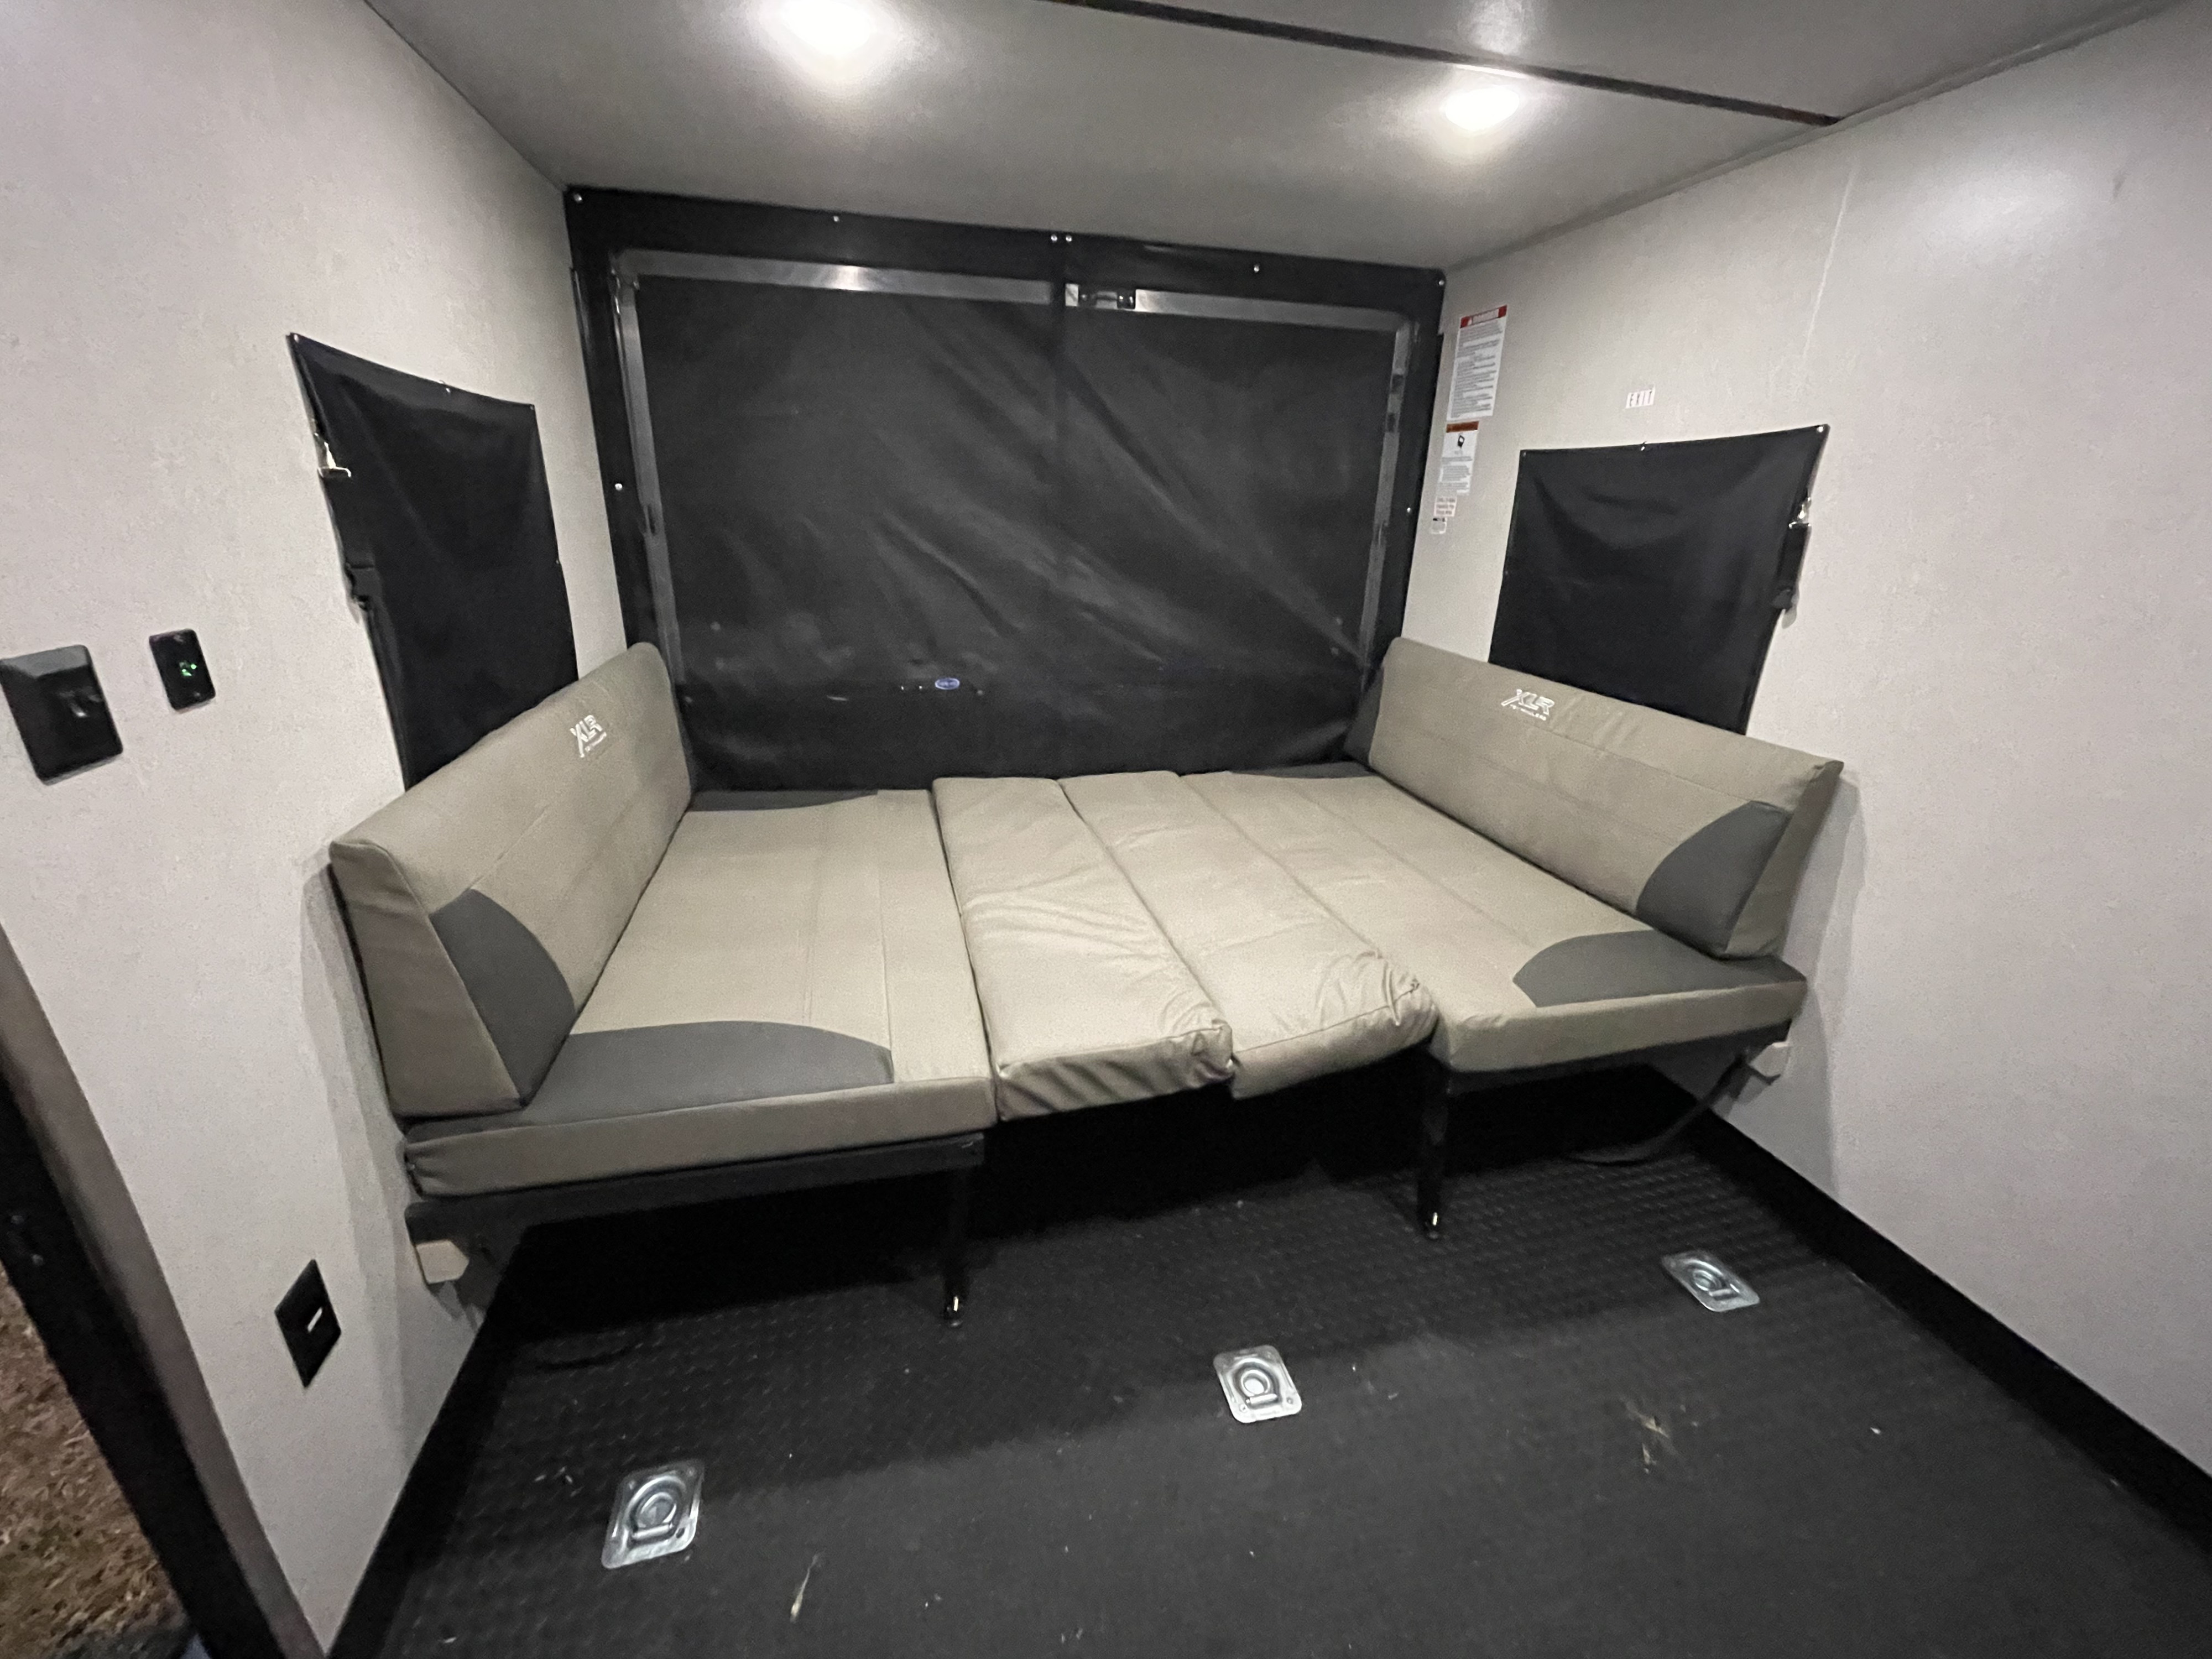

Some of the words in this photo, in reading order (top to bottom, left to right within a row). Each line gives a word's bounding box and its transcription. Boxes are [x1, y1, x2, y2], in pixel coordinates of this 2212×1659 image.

[1629, 390, 1652, 406] EXIT
[1501, 688, 1555, 716] XLR
[569, 715, 603, 758] XLR
